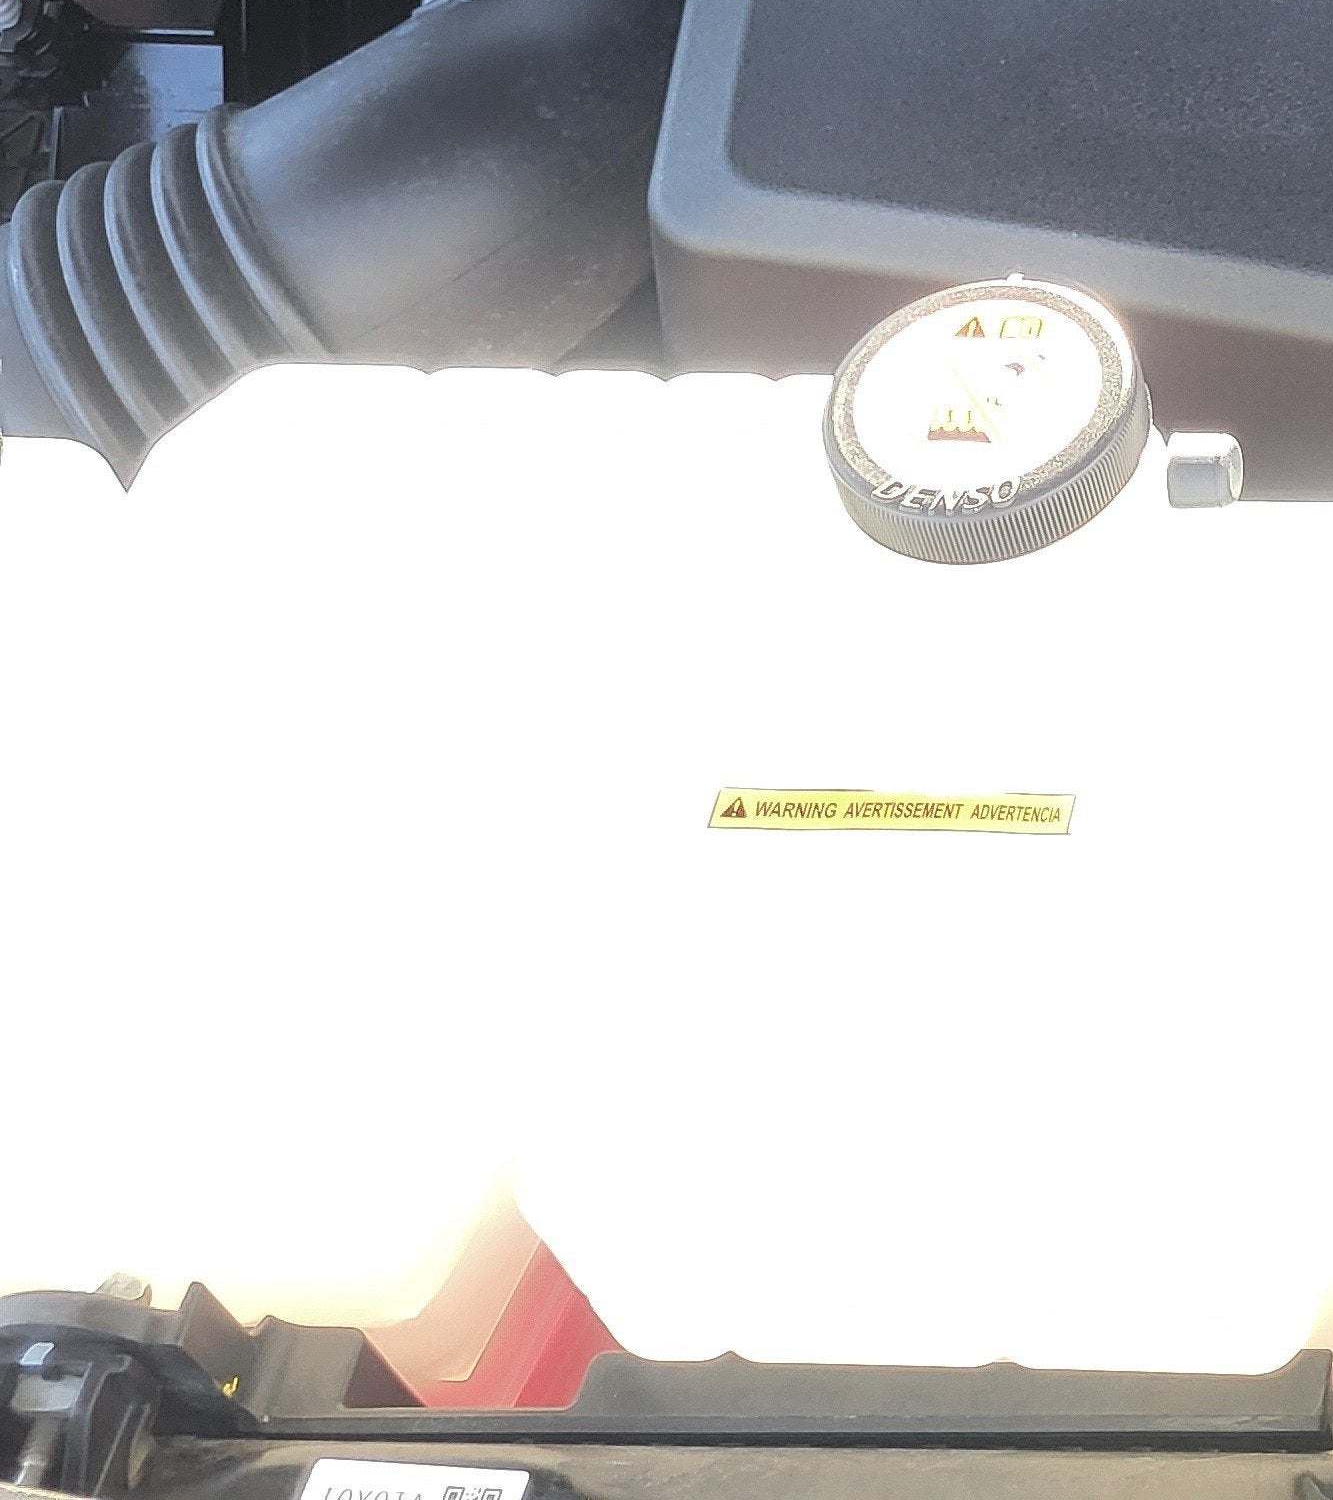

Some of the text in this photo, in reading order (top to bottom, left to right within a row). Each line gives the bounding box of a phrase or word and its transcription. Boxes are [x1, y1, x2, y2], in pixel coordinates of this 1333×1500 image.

[870, 476, 1021, 514] DENSO
[755, 801, 1061, 822] WARNING AVERTISSEMENT ADVERTENCIA
